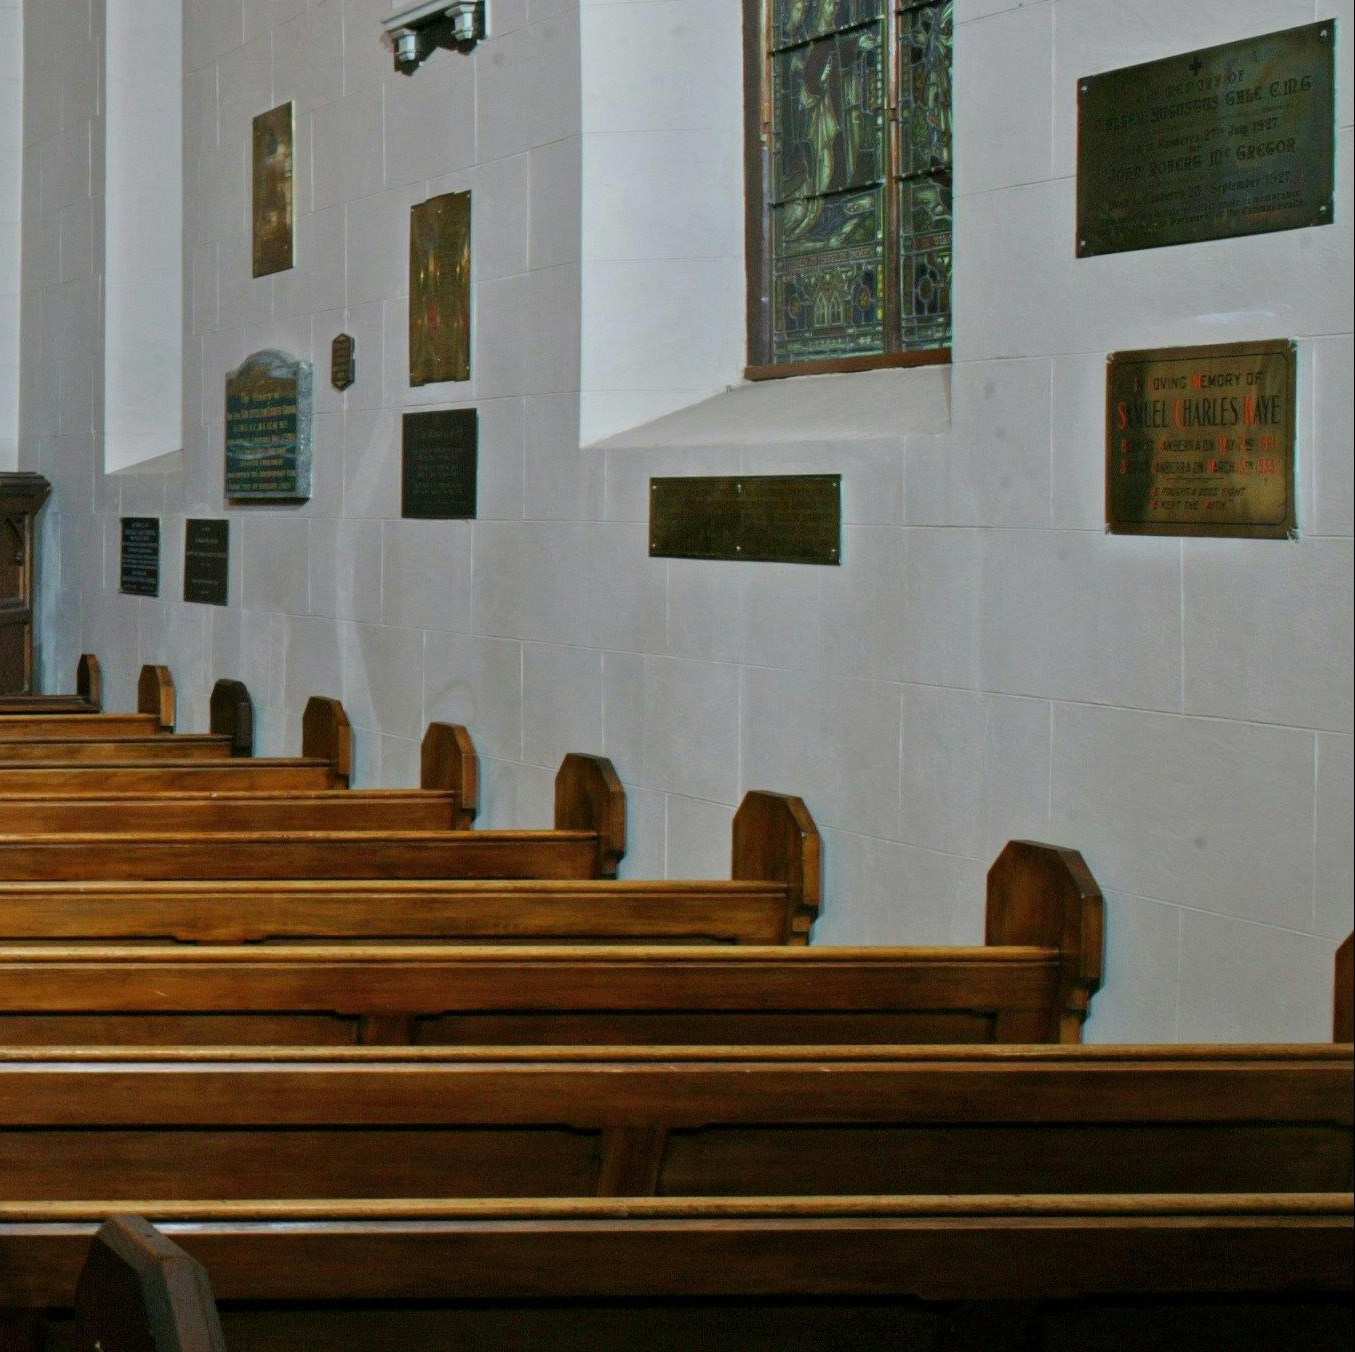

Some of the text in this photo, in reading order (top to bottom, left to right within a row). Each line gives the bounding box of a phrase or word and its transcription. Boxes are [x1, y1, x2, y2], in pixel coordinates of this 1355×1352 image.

[1235, 137, 1296, 162] GREGOR
[1147, 376, 1187, 393] LOVING
[1191, 373, 1241, 390] MEMORY
[1246, 370, 1263, 387] OF
[1172, 396, 1238, 428] CHARLES
[1243, 394, 1281, 426] KAYE
